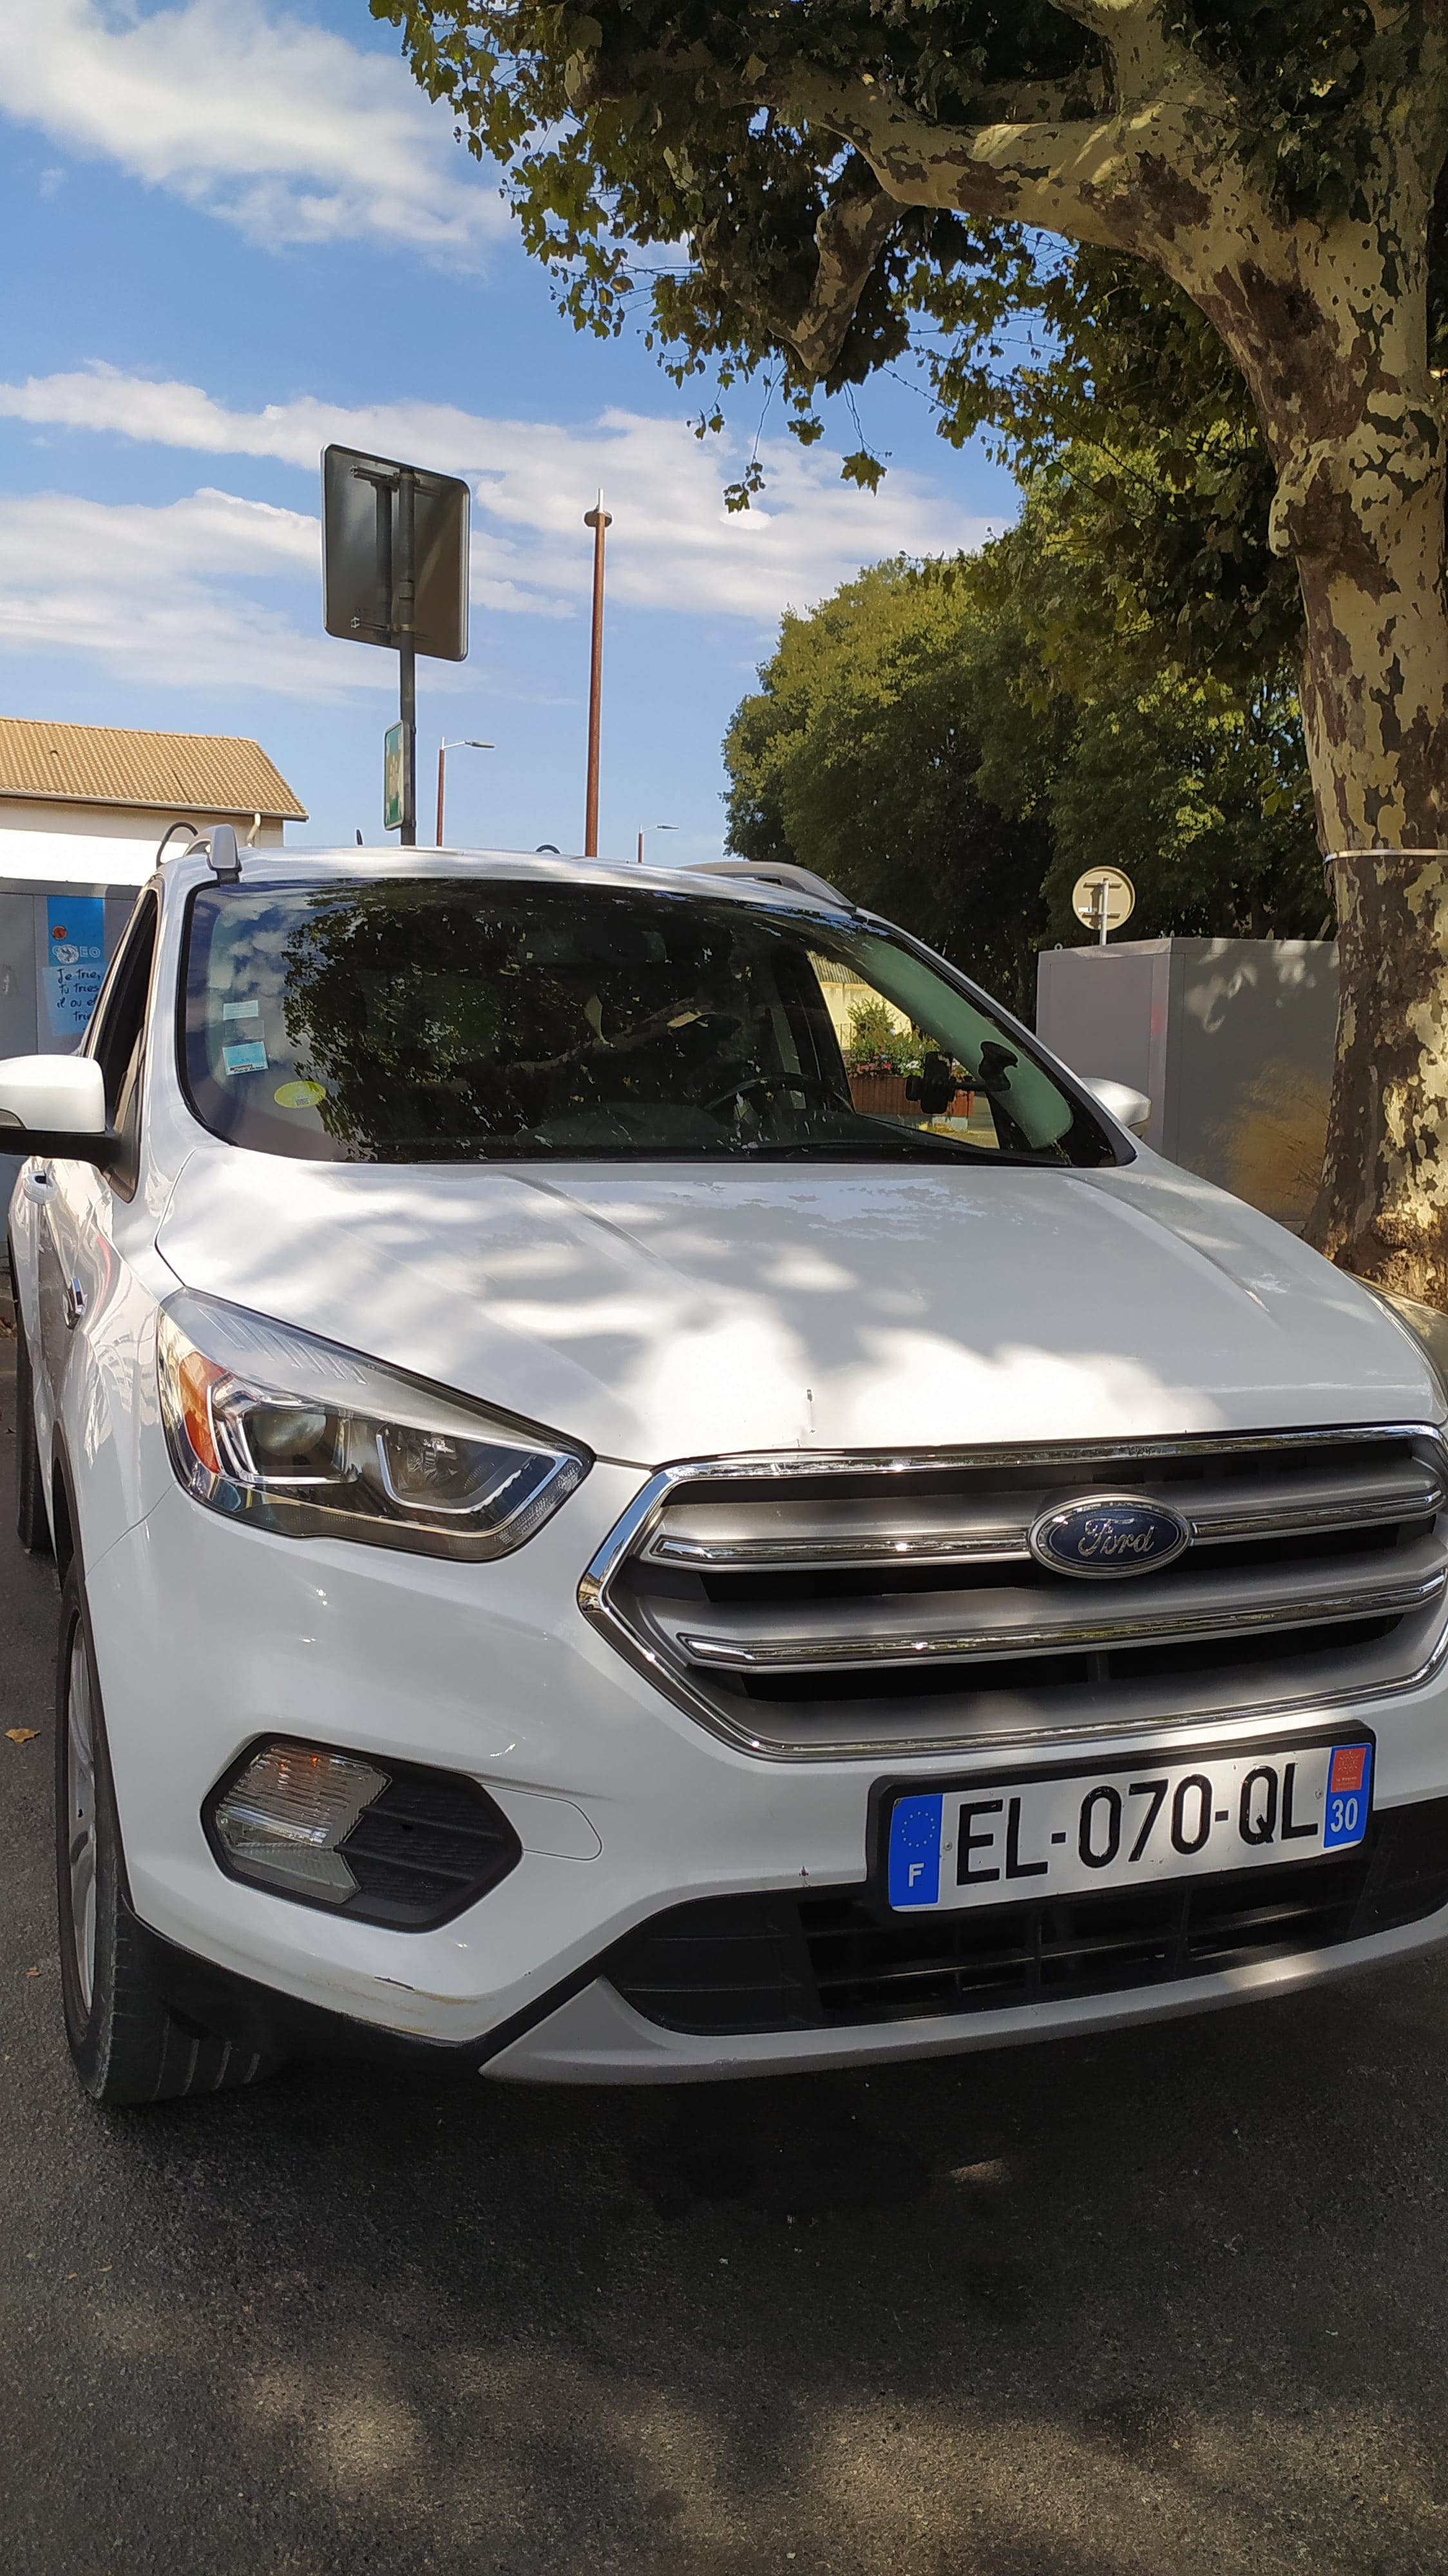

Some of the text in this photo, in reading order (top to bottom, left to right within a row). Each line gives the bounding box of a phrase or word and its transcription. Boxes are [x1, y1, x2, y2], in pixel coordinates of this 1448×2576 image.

[57, 969, 72, 984] Je
[59, 984, 69, 994] tu
[1078, 1517, 1155, 1557] Ford
[956, 1763, 1319, 1886] EL-070-QL
[1330, 1797, 1358, 1833] 30
[908, 1862, 924, 1888] F
